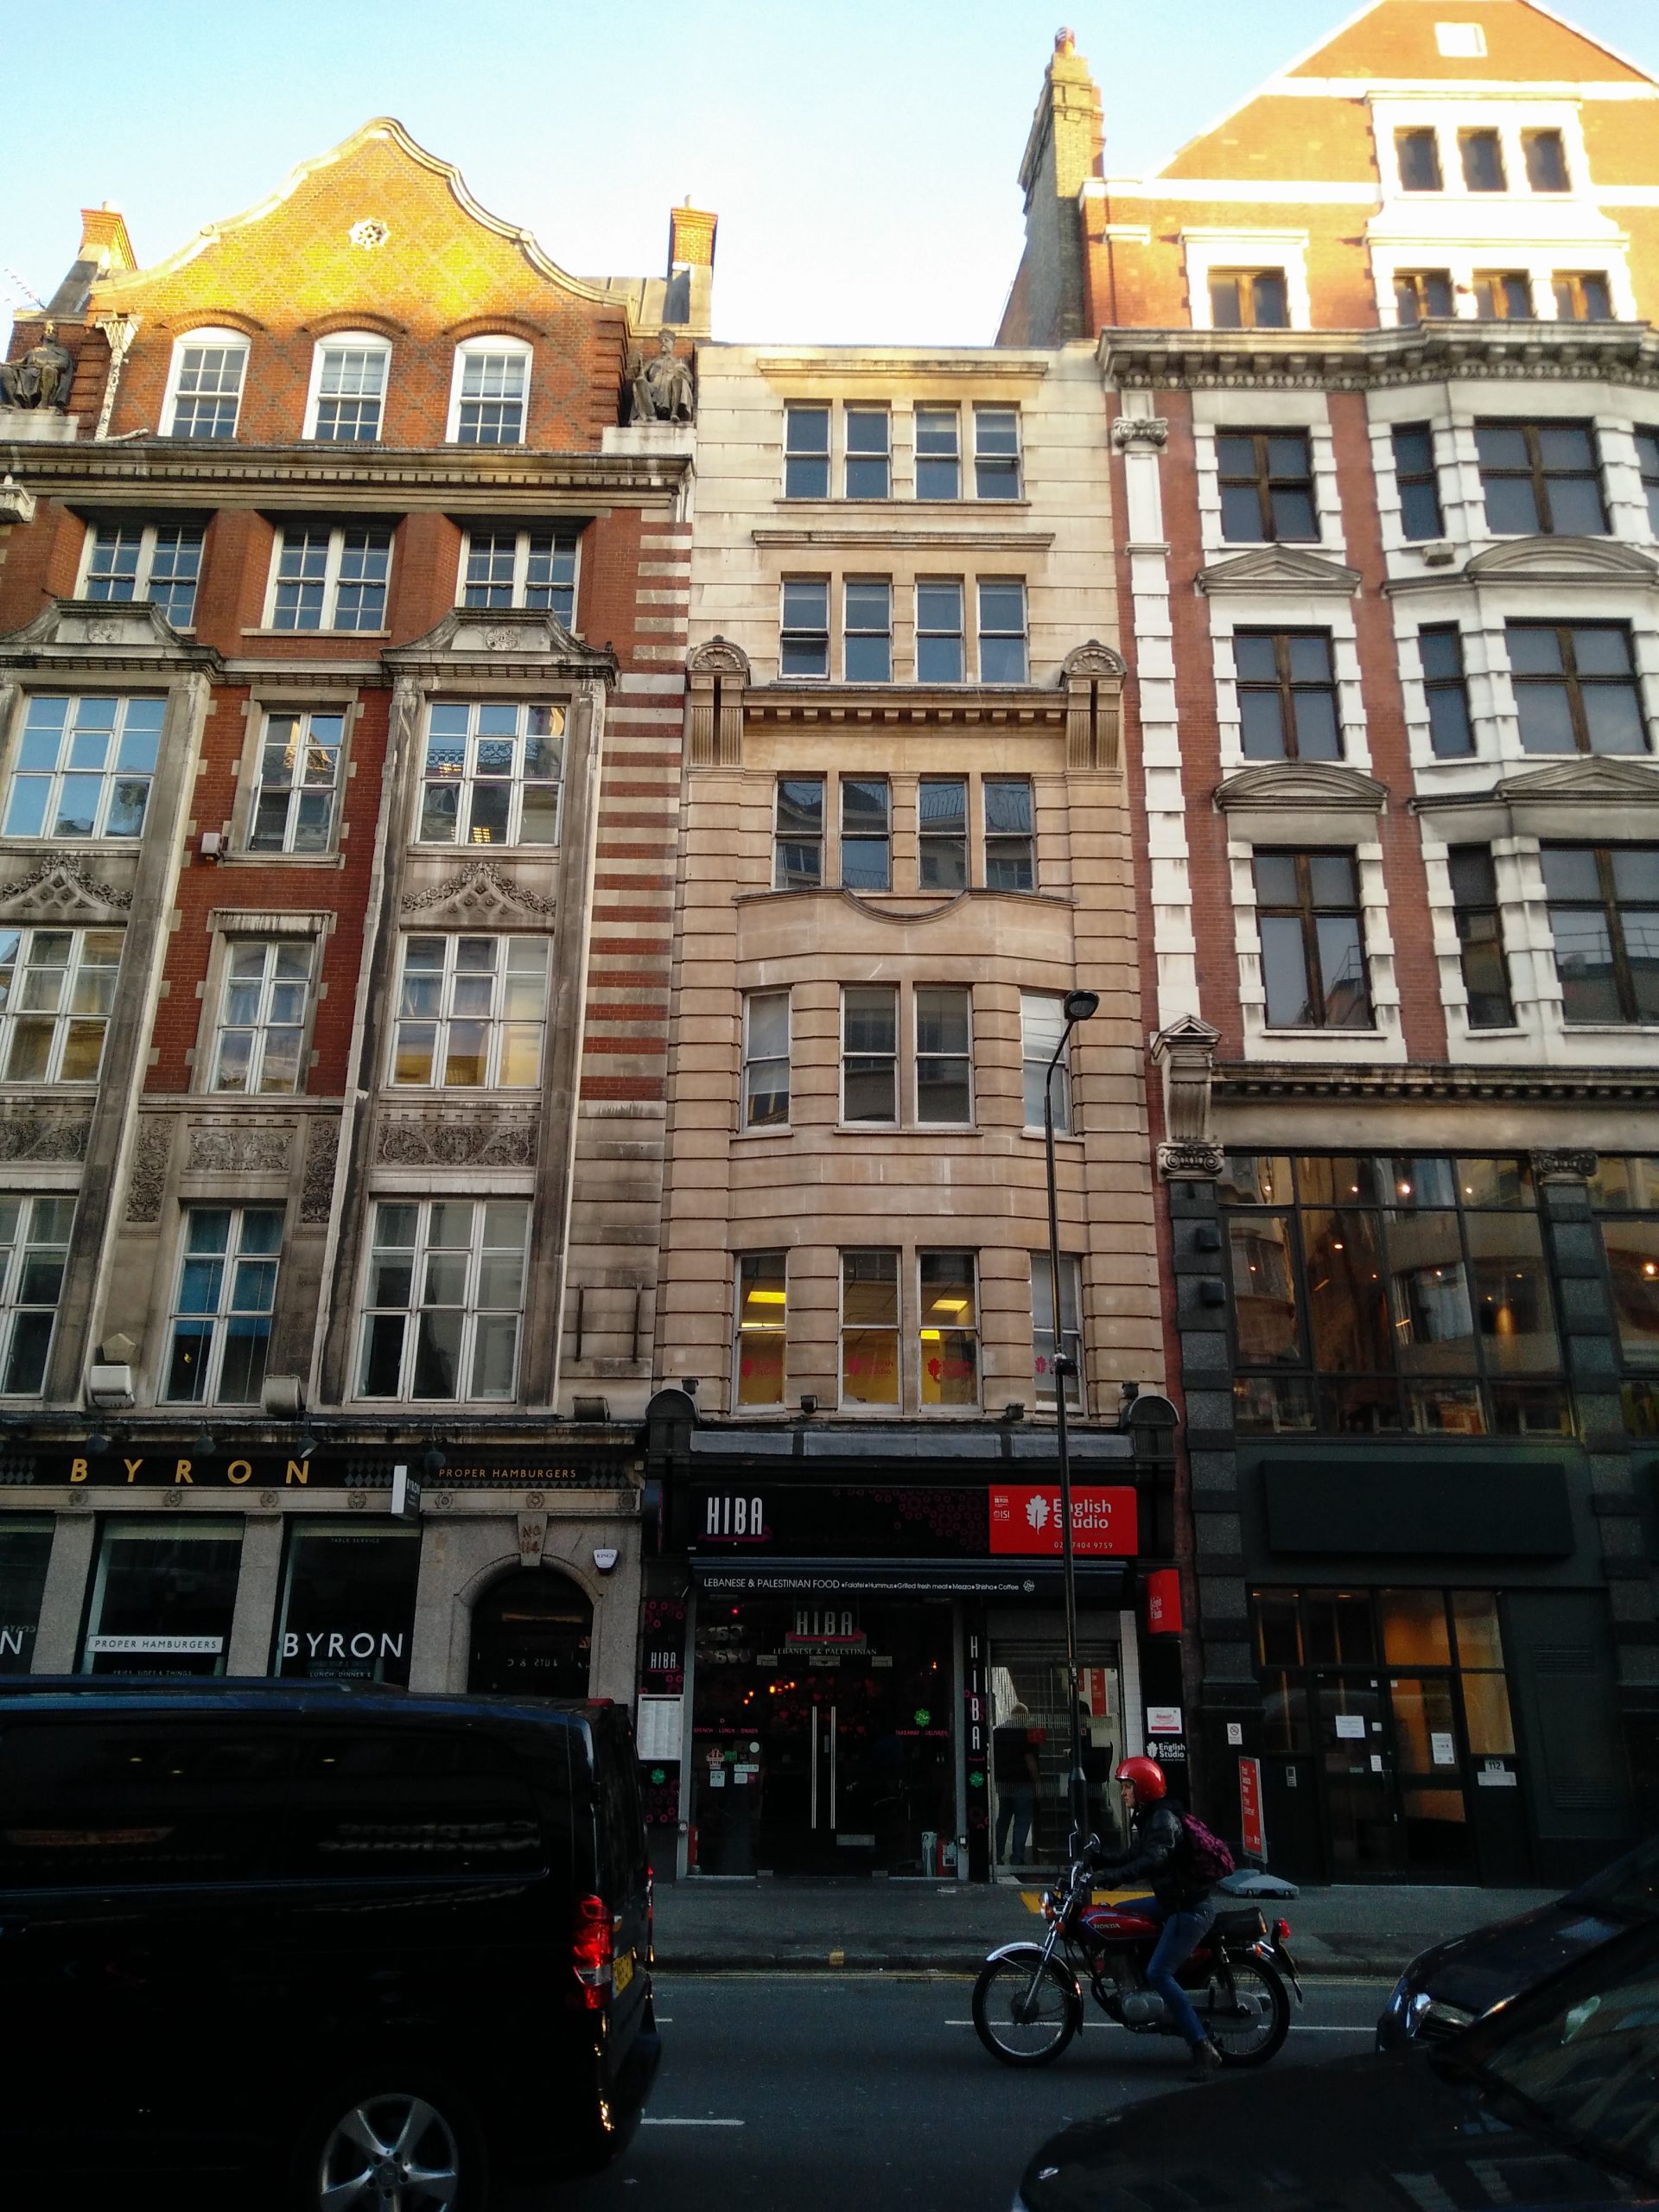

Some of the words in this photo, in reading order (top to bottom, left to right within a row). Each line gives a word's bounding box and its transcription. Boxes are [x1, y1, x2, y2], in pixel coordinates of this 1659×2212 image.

[70, 1459, 309, 1484] BYRON
[439, 1469, 486, 1478] PROPER
[493, 1469, 576, 1478] HAMBURGERS
[1053, 1498, 1112, 1516] Eglish
[707, 1497, 763, 1535] HIBA
[1053, 1515, 1109, 1529] Sudio
[703, 1578, 746, 1587] LEBANESE
[747, 1579, 755, 1587] &
[757, 1579, 810, 1588] PALESTINIAN
[813, 1580, 840, 1589] FOOD
[796, 1611, 853, 1636] HIBA
[143, 1640, 217, 1649] HAMBURGERS
[283, 1632, 404, 1658] BYRON
[650, 1651, 677, 1669] HIBA
[1158, 1743, 1186, 1751] English
[1489, 1761, 1501, 1770] 112
